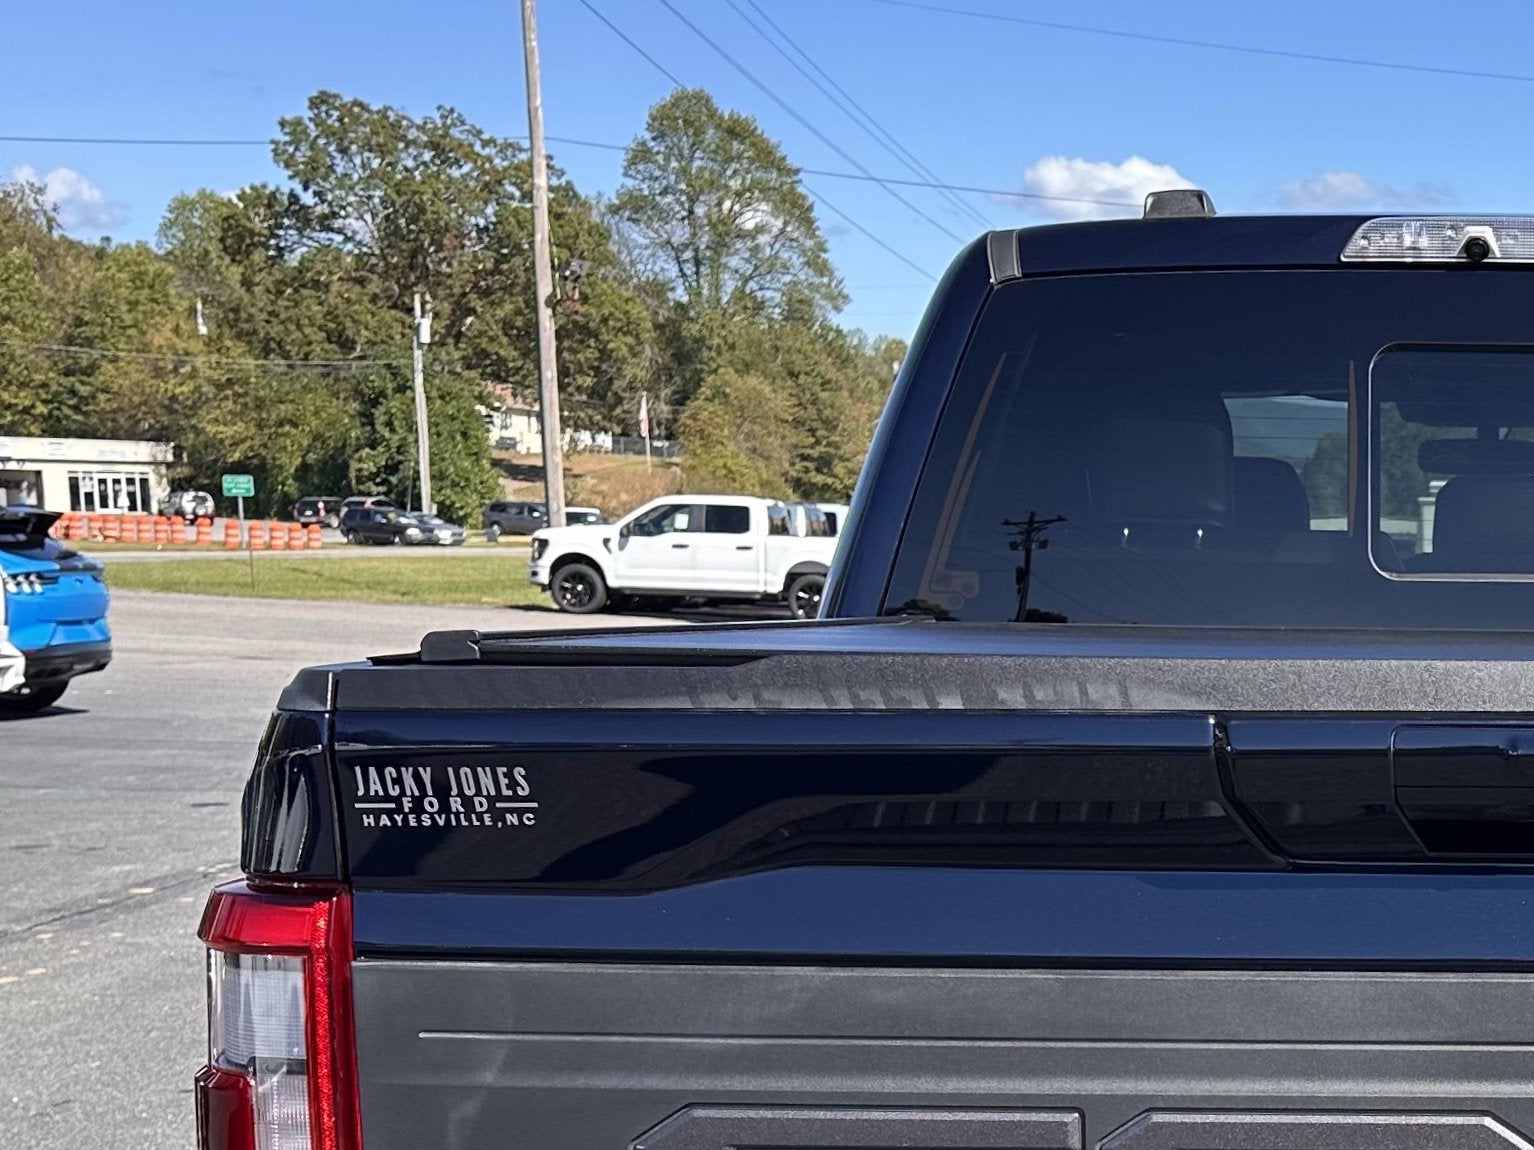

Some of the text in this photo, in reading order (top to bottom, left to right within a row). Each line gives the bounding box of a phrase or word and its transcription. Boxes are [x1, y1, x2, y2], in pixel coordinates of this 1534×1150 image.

[354, 765, 531, 797] JACKY JONES
[401, 797, 489, 813] FORD
